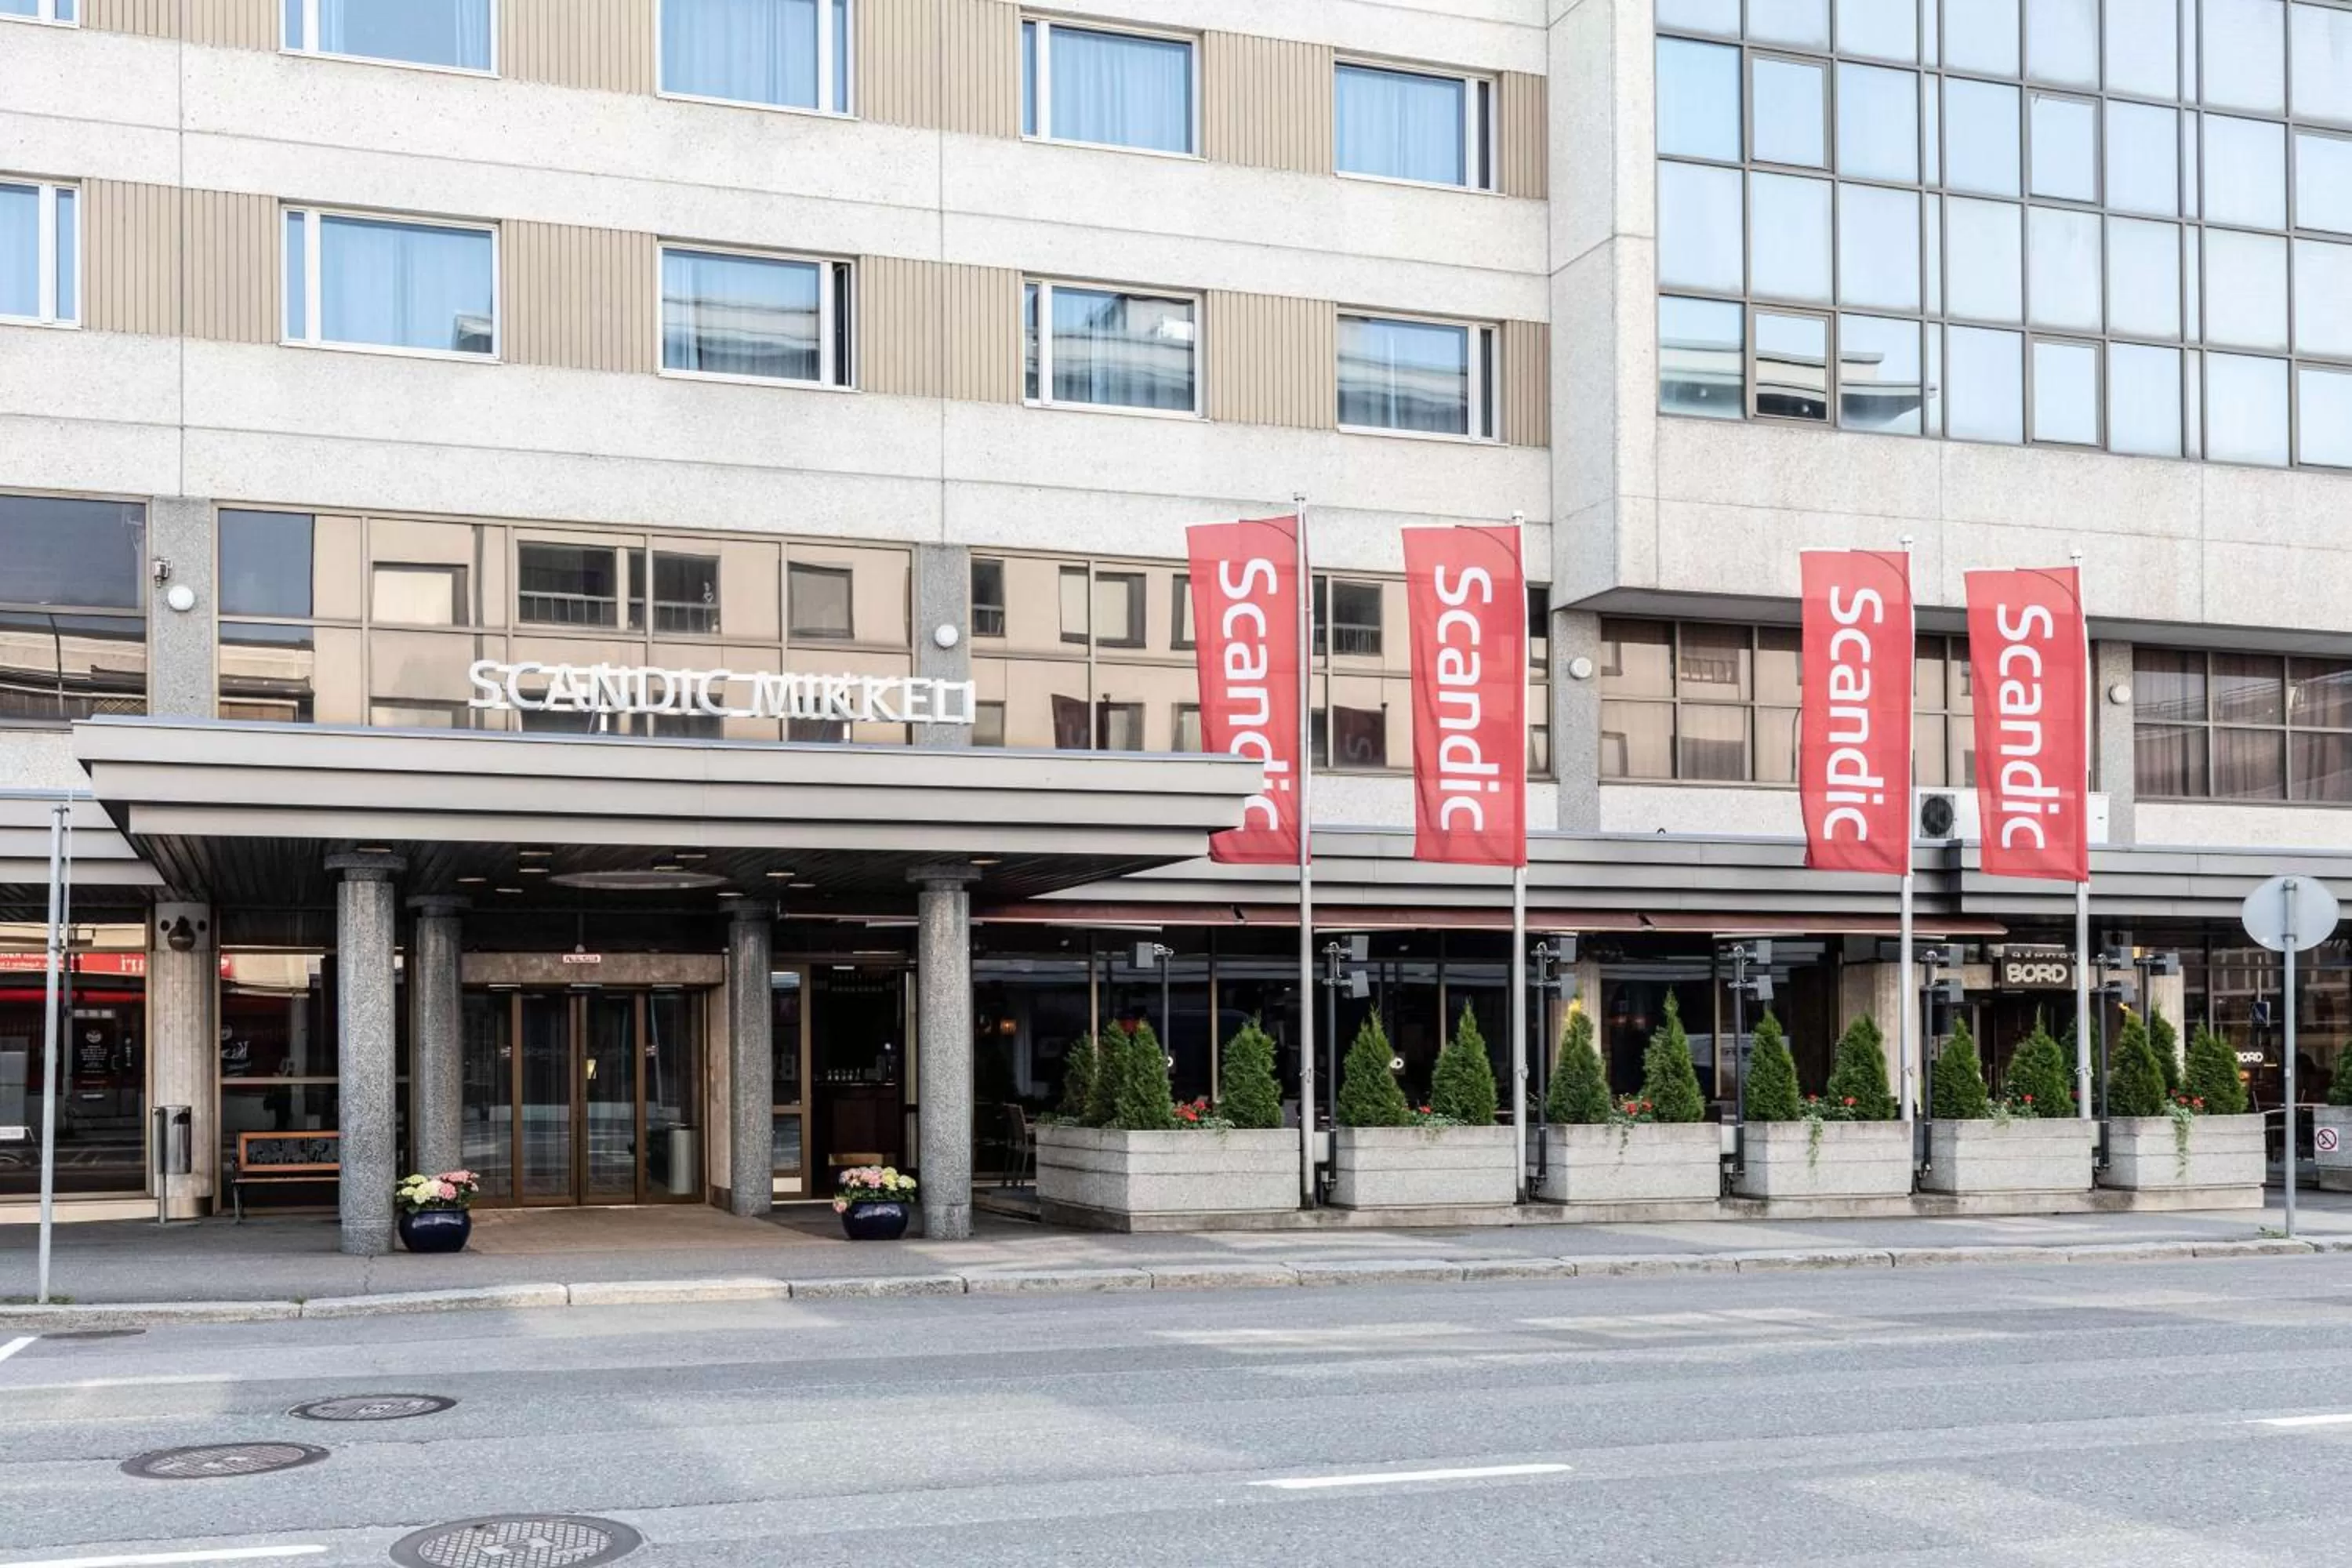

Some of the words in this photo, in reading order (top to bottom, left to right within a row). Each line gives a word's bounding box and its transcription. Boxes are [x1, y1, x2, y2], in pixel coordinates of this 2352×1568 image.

[469, 659, 731, 717] SCANDIC
[752, 671, 976, 724] MIKKELI
[1434, 564, 1500, 832] Scandic
[1823, 586, 1884, 842] Scandic
[1996, 603, 2060, 850] Scandic
[2006, 962, 2067, 984] BORD
